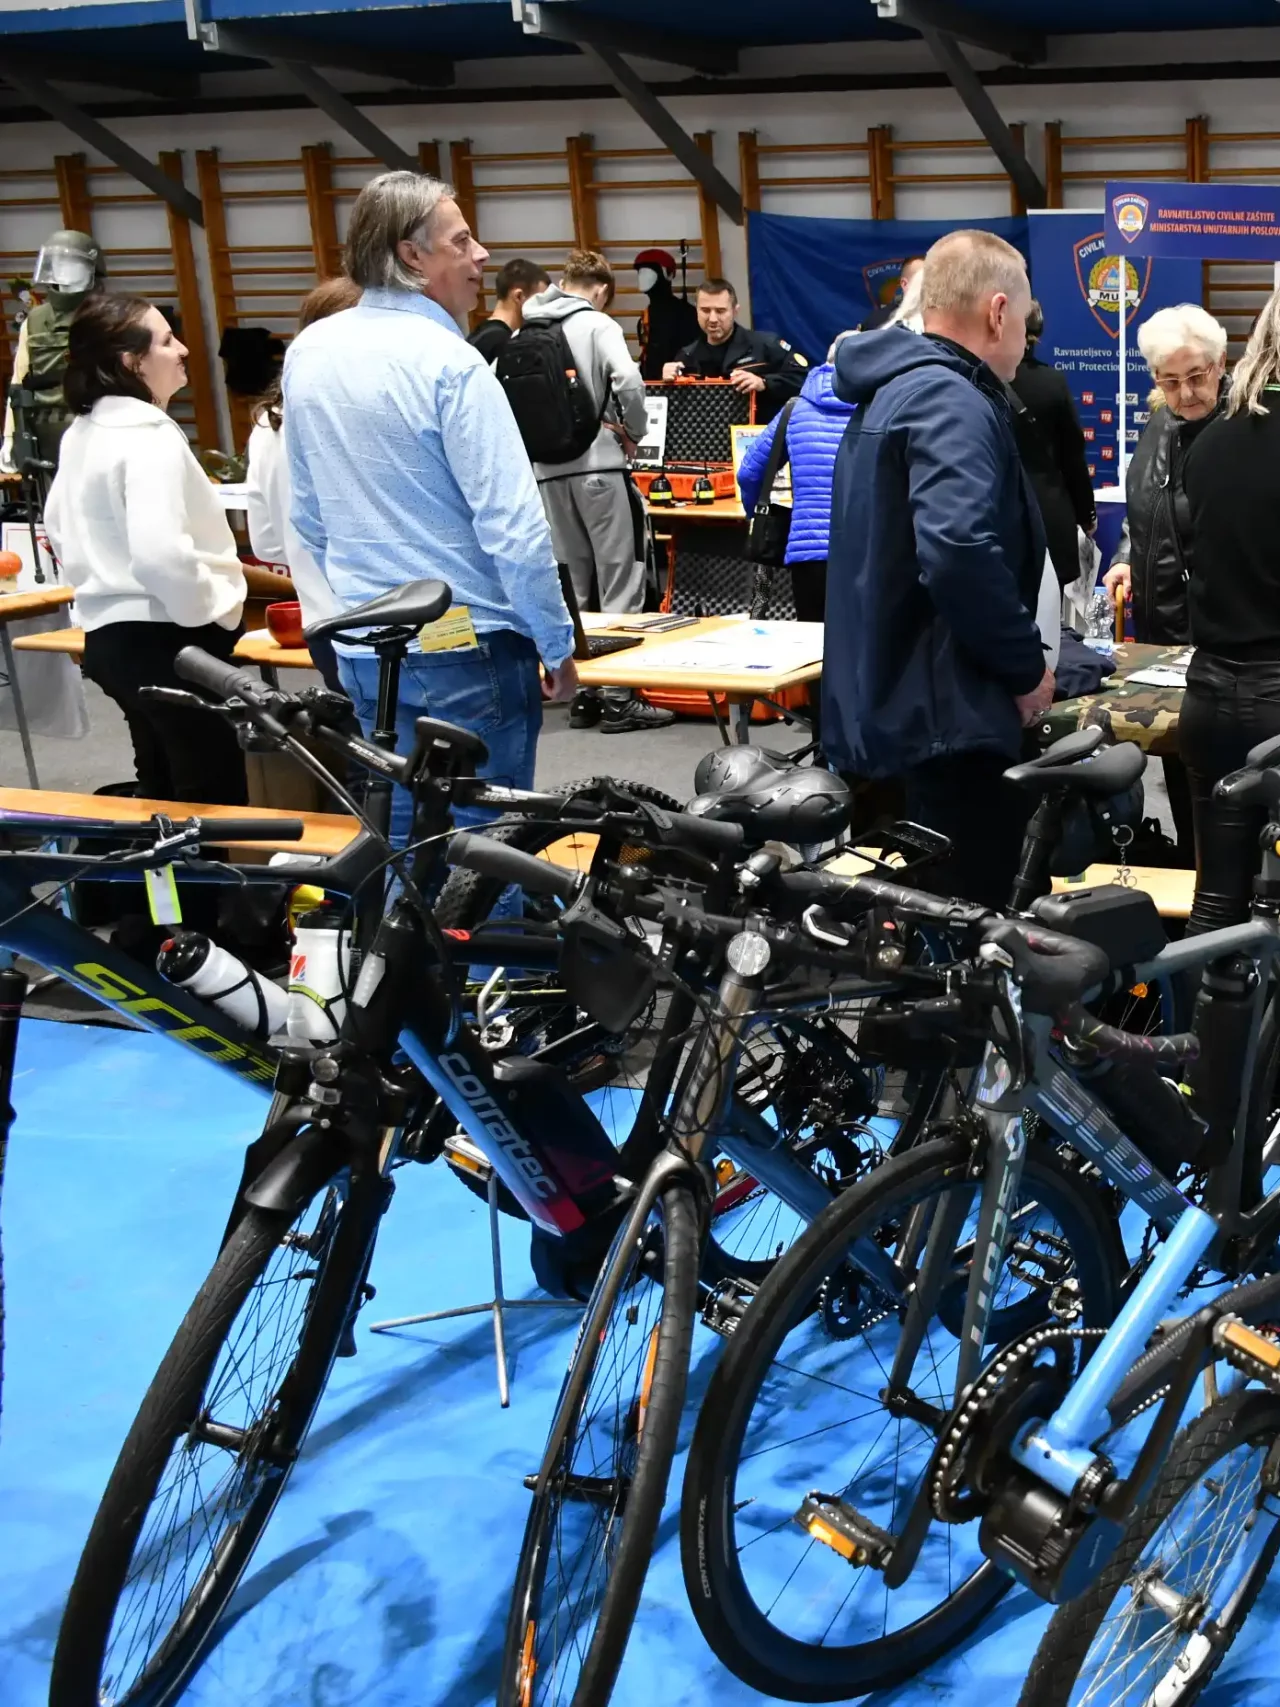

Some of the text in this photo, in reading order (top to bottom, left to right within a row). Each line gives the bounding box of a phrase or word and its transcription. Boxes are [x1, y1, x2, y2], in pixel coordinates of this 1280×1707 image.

[1158, 209, 1275, 223] RAVNATELJSTVO CIVILNE ZAŠTITE
[1150, 223, 1202, 234] MINISTARSTVA
[1203, 224, 1249, 236] UNUTARNJIH
[1053, 347, 1113, 359] Ravnateljstvo
[1054, 360, 1076, 371] Civil
[1079, 361, 1120, 372] Protectio
[438, 1052, 558, 1199] corratec
